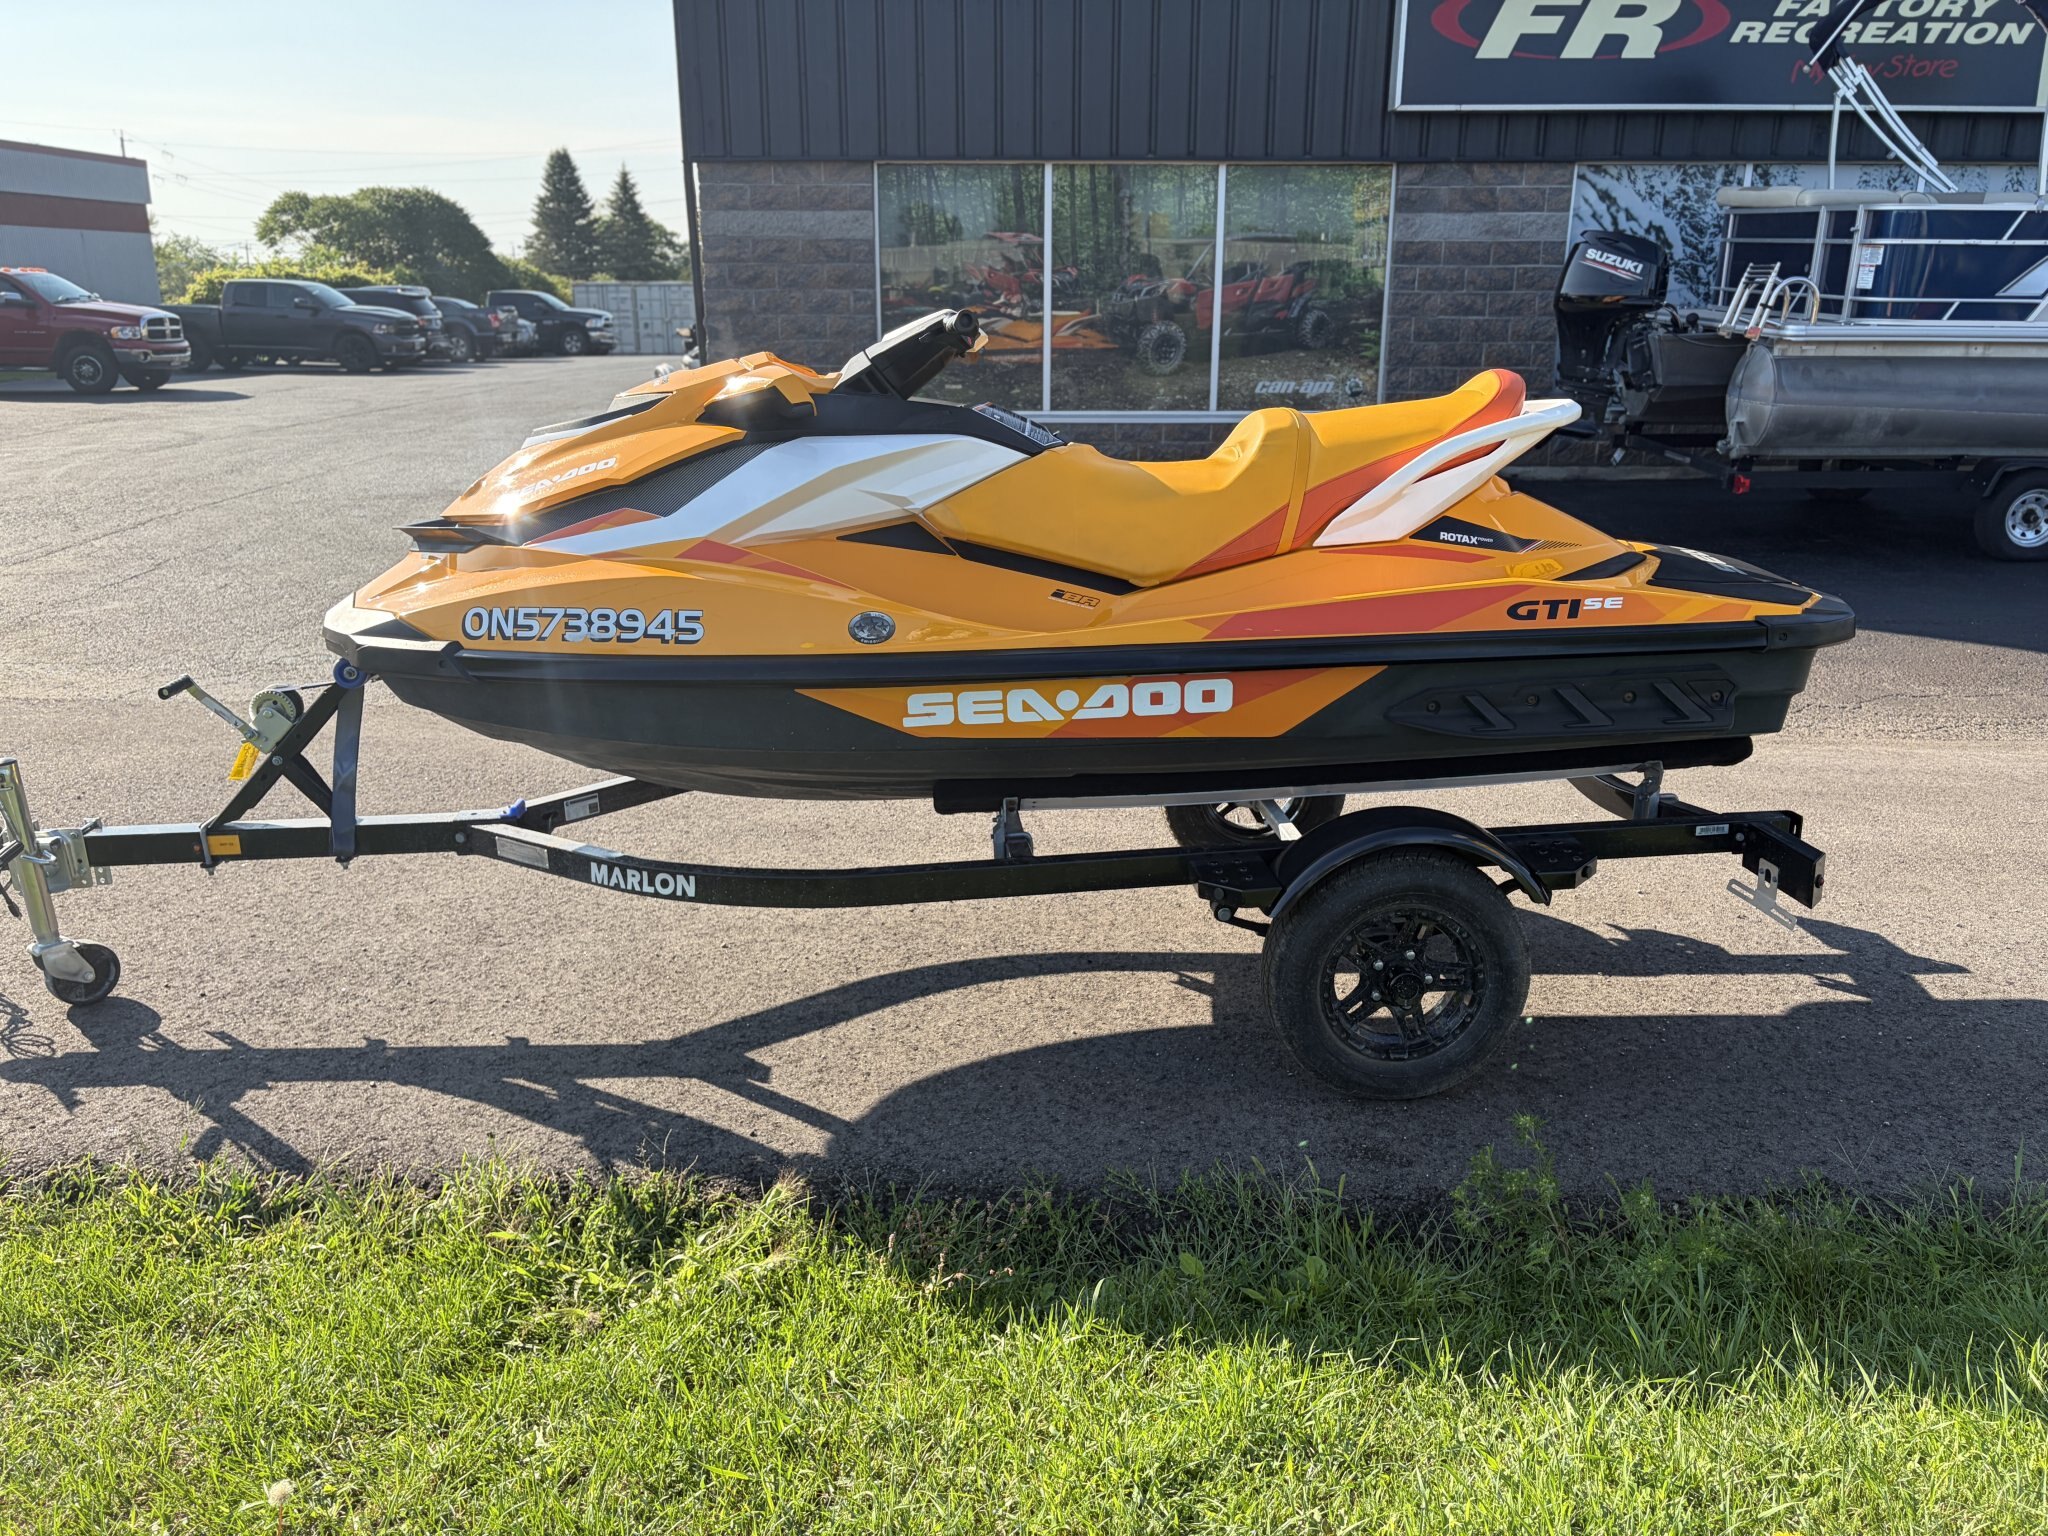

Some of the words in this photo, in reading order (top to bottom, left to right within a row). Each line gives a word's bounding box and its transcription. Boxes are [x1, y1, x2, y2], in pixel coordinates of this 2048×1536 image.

[1772, 0, 1994, 17] FATORY
[1475, 0, 1682, 59] FR
[1883, 53, 1960, 79] Store
[1585, 248, 1644, 274] SUZUKI
[1440, 531, 1478, 545] ROTAX
[1506, 598, 1582, 621] GTI
[1583, 596, 1624, 610] SE
[462, 606, 705, 644] ON5738945
[590, 861, 696, 898] MARLON
